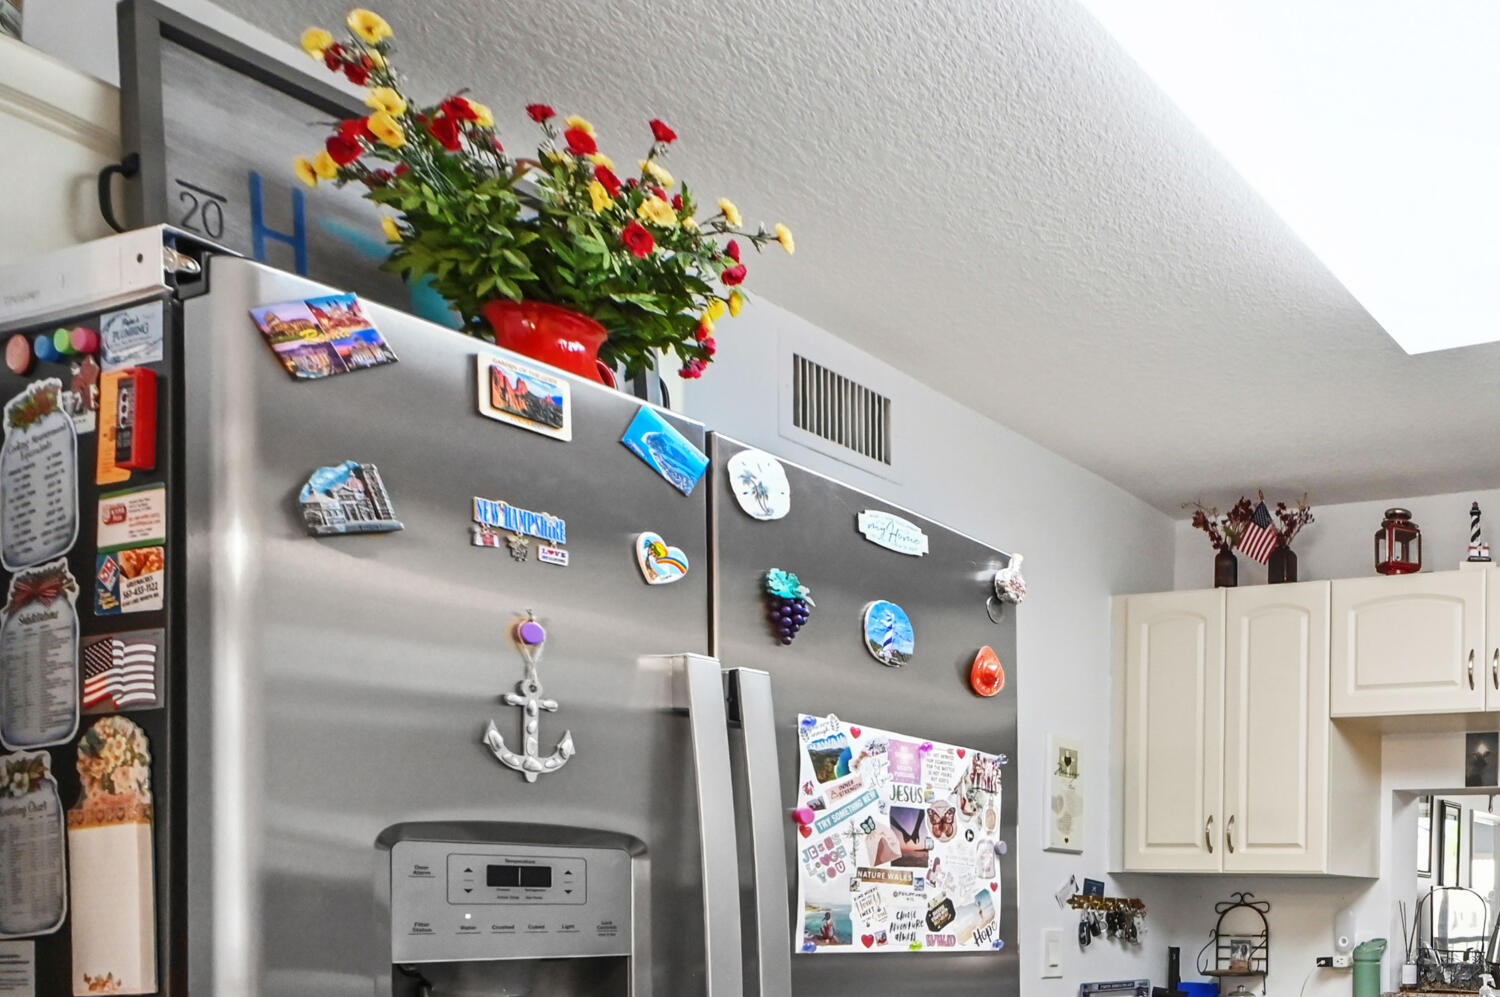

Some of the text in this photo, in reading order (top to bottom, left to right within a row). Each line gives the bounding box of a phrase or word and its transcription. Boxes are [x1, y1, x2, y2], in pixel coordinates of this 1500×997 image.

[180, 191, 224, 239] 20
[477, 498, 566, 543] NEW HAMPSHIRE
[838, 780, 854, 790] INNER
[838, 783, 862, 799] STRENGTH
[890, 784, 923, 803] JESUS
[817, 790, 878, 831] TRY SOMETHING NEW
[857, 870, 912, 882] NATURE WALKS
[973, 921, 998, 947] Hope
